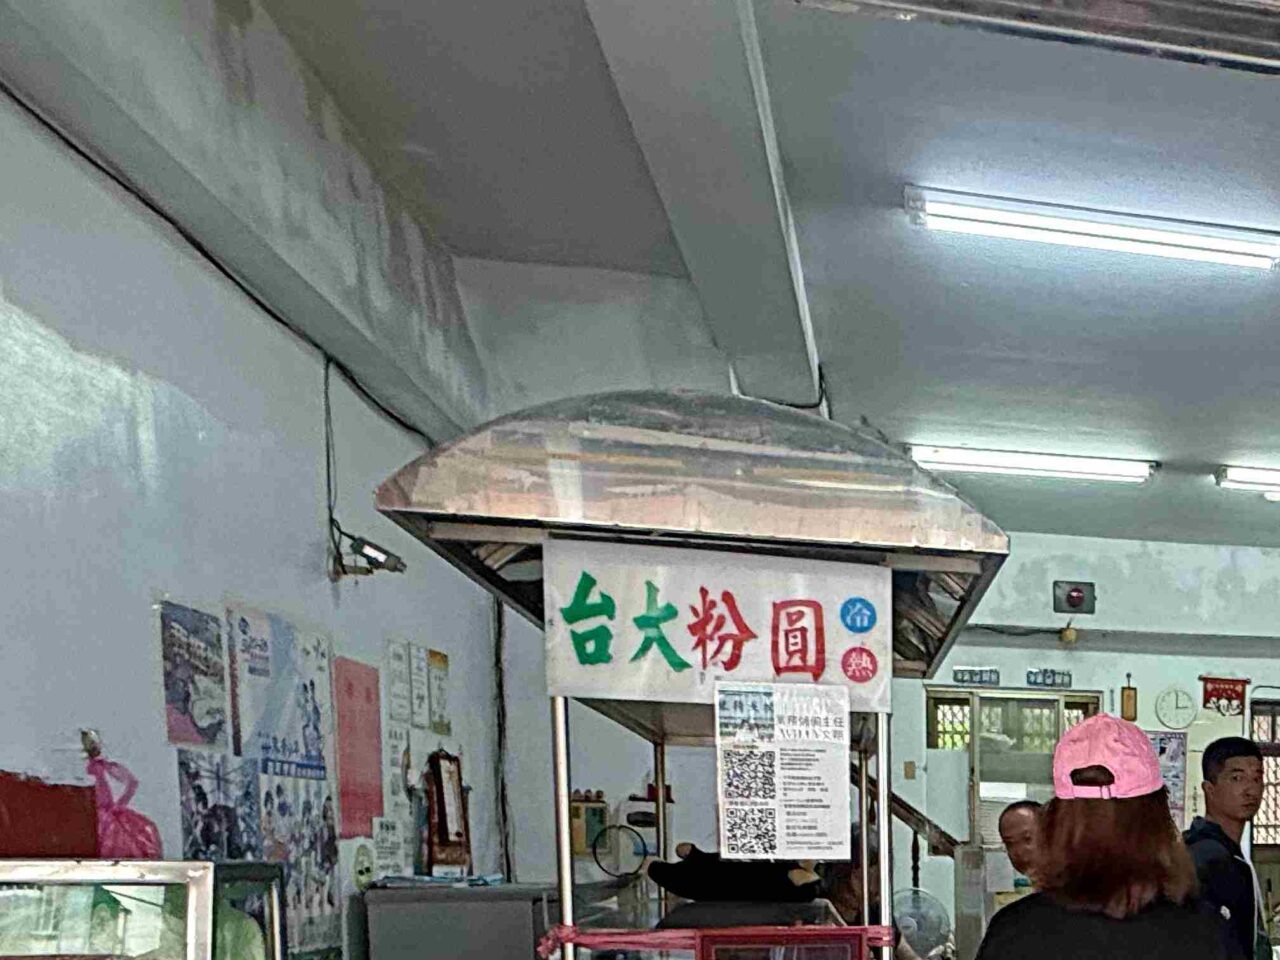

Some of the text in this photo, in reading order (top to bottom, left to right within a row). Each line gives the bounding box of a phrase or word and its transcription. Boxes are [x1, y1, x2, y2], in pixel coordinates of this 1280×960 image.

[559, 570, 827, 683] 台大粉圓
[844, 601, 872, 629] 冷
[844, 651, 875, 679] 熱
